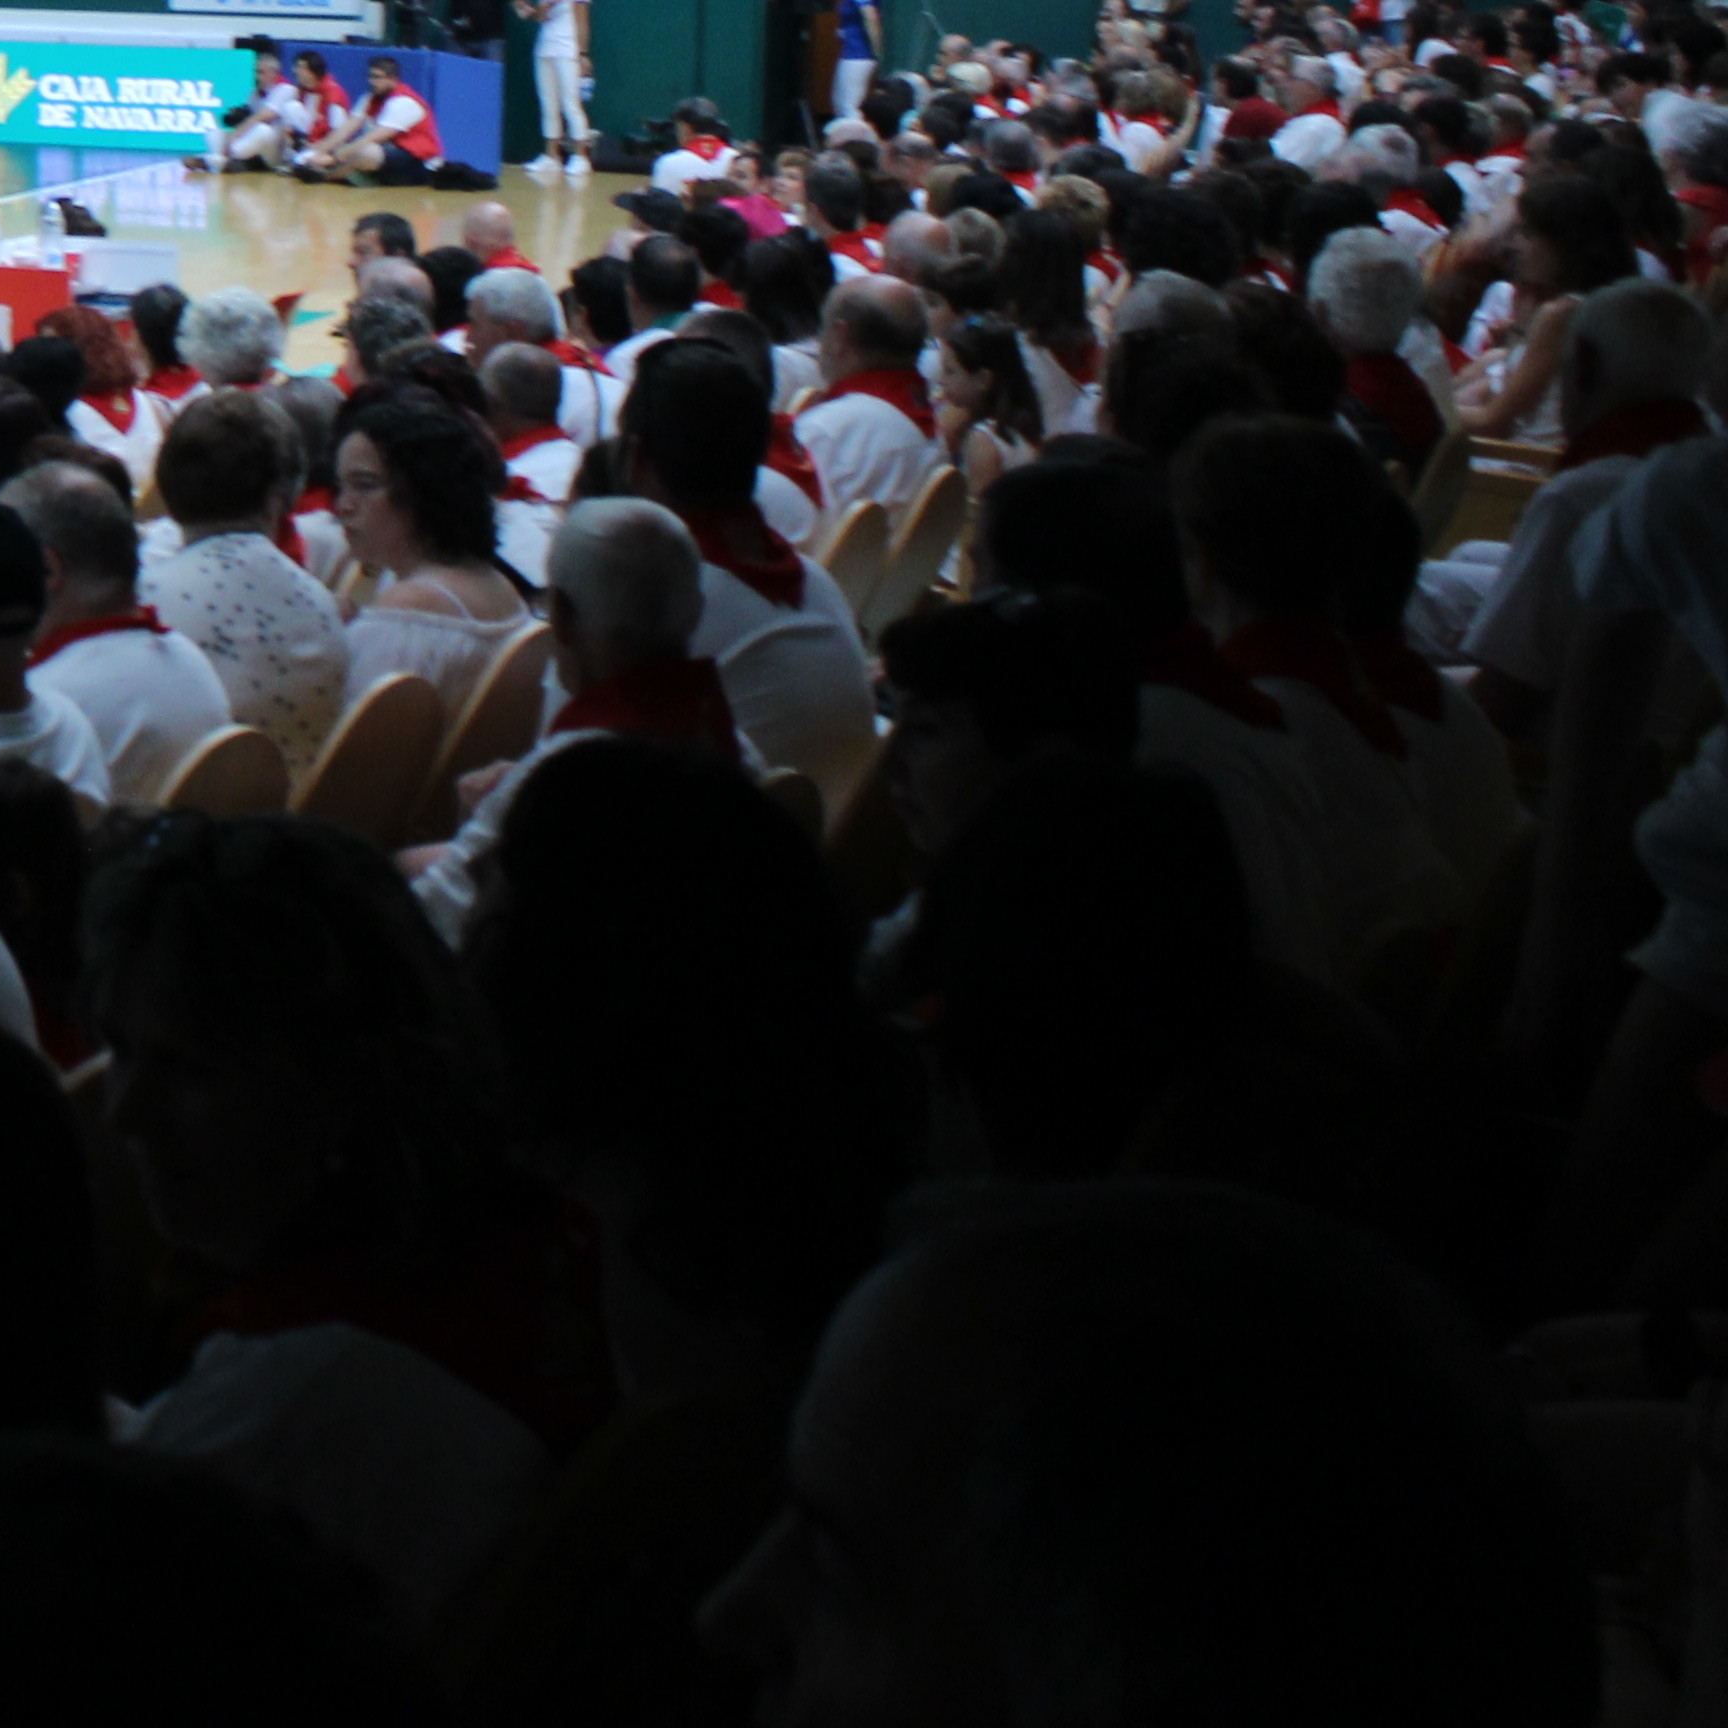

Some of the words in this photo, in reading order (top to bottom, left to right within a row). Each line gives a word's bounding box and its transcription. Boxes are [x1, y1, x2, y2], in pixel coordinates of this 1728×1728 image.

[38, 73, 114, 103] CAJA
[116, 76, 223, 107] RURAL
[37, 102, 77, 128] DE
[81, 104, 220, 134] NAVARRA
